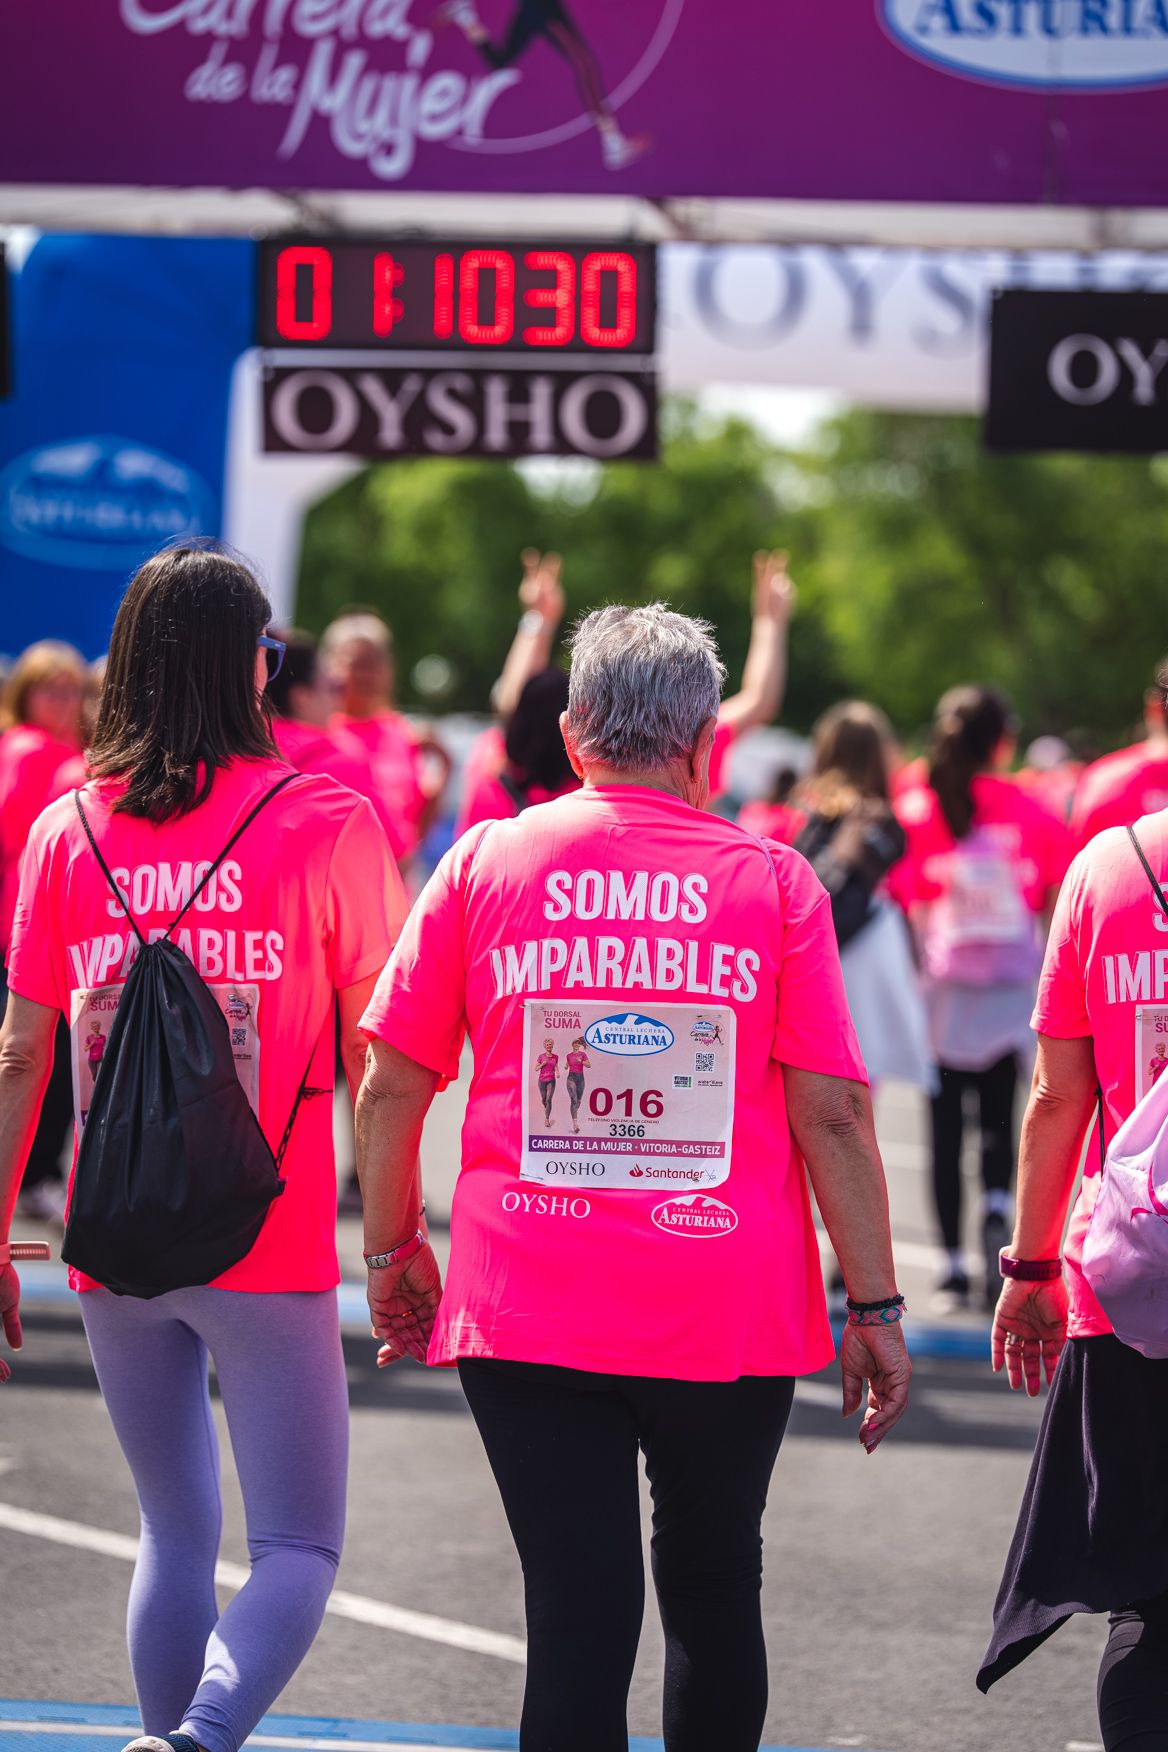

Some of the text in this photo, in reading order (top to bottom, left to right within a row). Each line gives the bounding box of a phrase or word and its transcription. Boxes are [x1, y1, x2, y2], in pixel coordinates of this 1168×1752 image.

[184, 38, 247, 101] de
[276, 31, 521, 181] Mujer
[271, 369, 648, 457] OYSHO
[106, 860, 243, 918] SOMOS
[543, 869, 708, 924] SOMOS
[489, 936, 761, 1003] IMPARABLES
[90, 1000, 118, 1011] SUM
[553, 1010, 582, 1018] DORSAL
[544, 1017, 582, 1029] SUMA
[591, 1027, 668, 1046] ASTURIANA
[589, 1087, 664, 1119] 016
[609, 1123, 646, 1137] 3366
[531, 1138, 721, 1156] CARRERA DE LA MUJER VITORIA-GASTEIZ
[546, 1160, 705, 1181] OYSHO Santander
[501, 1191, 591, 1219] OYSHO
[672, 1207, 701, 1215] CENTRAL
[657, 1207, 732, 1229] ASTURIANA
